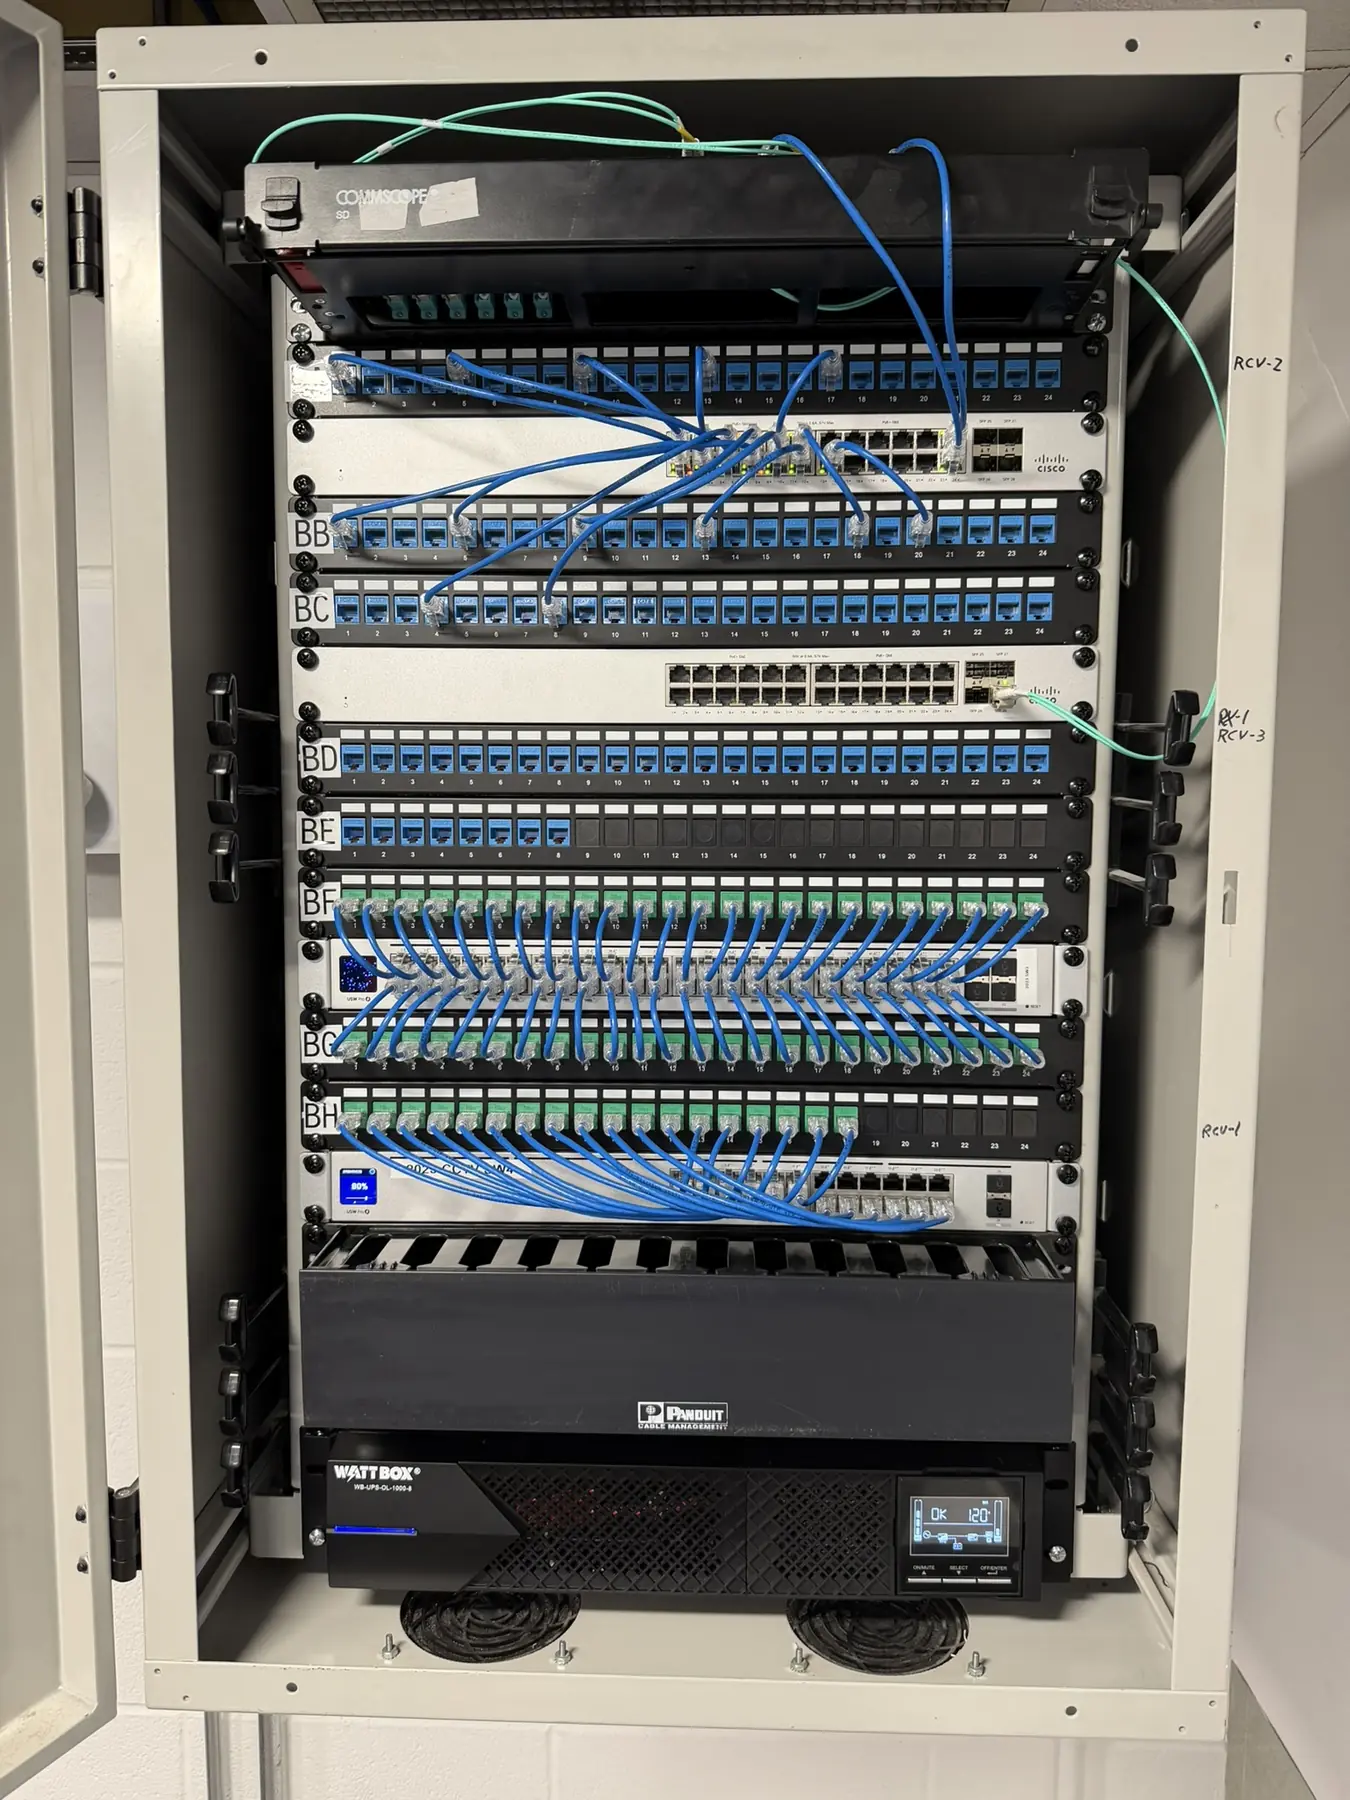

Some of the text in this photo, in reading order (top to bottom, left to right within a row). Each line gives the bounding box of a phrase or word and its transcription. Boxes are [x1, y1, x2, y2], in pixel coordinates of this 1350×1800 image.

[336, 189, 427, 205] COMMSCOPE
[336, 210, 350, 220] SD
[1037, 465, 1066, 473] CISCO
[295, 519, 330, 547] BB
[295, 594, 329, 622] BC
[1217, 728, 1266, 743] RCV-3
[302, 745, 338, 772] BD
[301, 817, 336, 845] BE
[303, 889, 337, 916] BF
[303, 1031, 336, 1057] BG
[305, 1103, 338, 1129] BH
[666, 1406, 725, 1421] PANDUIT
[638, 1422, 729, 1431] CABLE MANAGEMENT
[931, 1507, 988, 1523] OK 120
